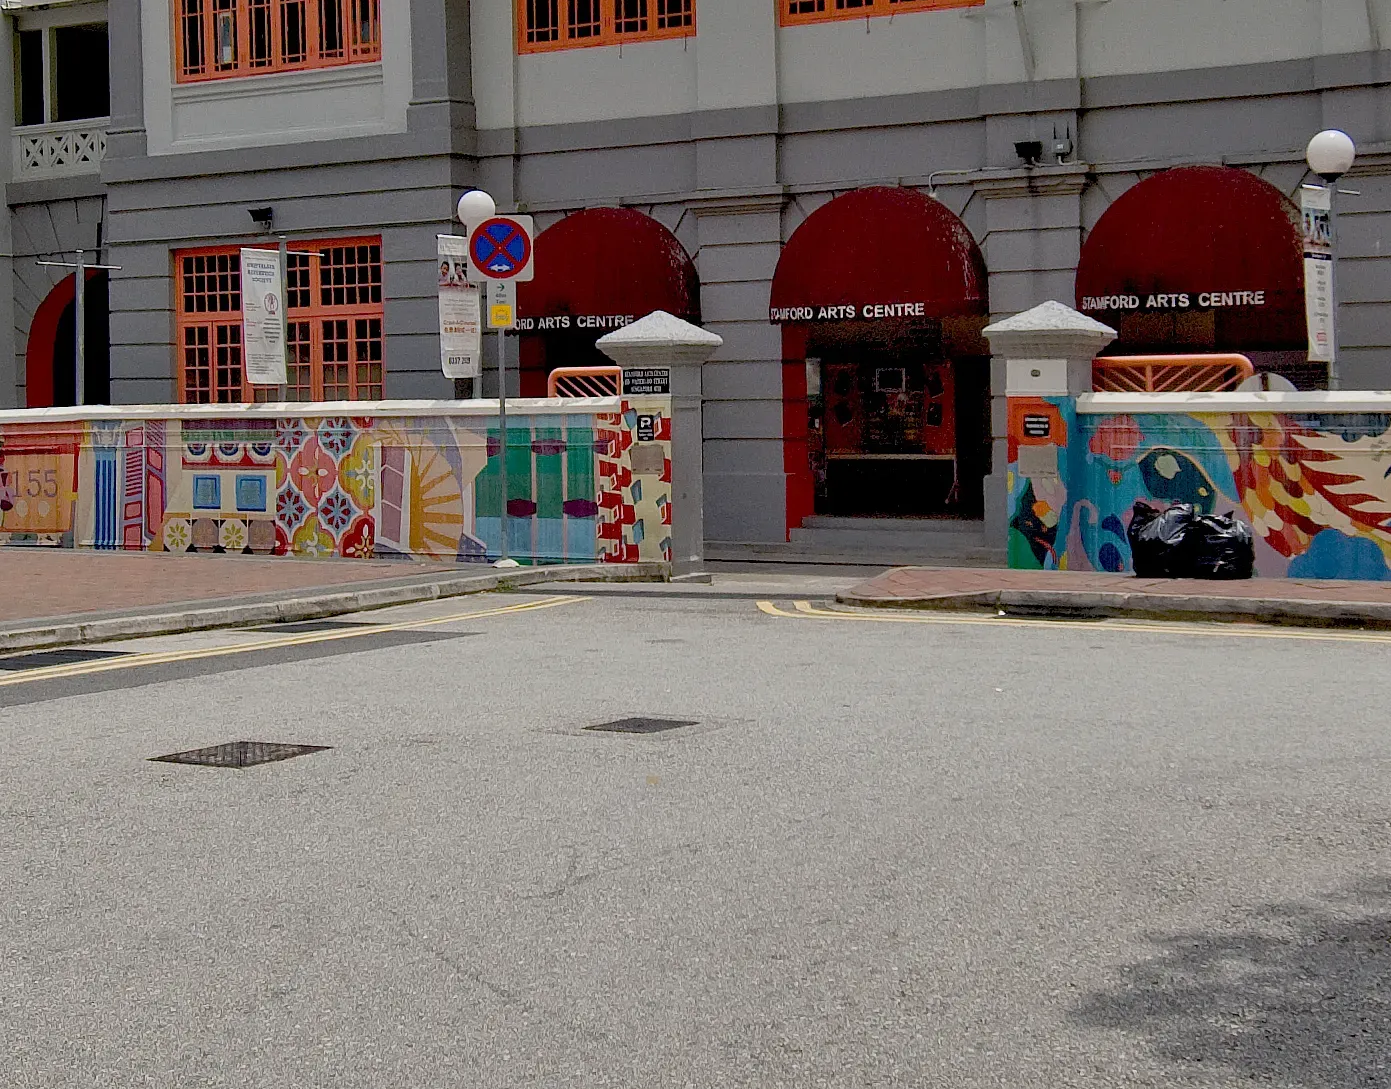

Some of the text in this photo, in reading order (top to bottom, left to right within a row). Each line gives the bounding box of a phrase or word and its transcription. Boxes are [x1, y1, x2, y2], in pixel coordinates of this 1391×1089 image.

[1082, 291, 1265, 310] STAMFORD ARTS CENTRE
[817, 304, 857, 319] ARTS
[862, 302, 925, 318] CENTRE
[515, 314, 635, 330] ORD ARTS CENTRE
[12, 469, 58, 498] 155
